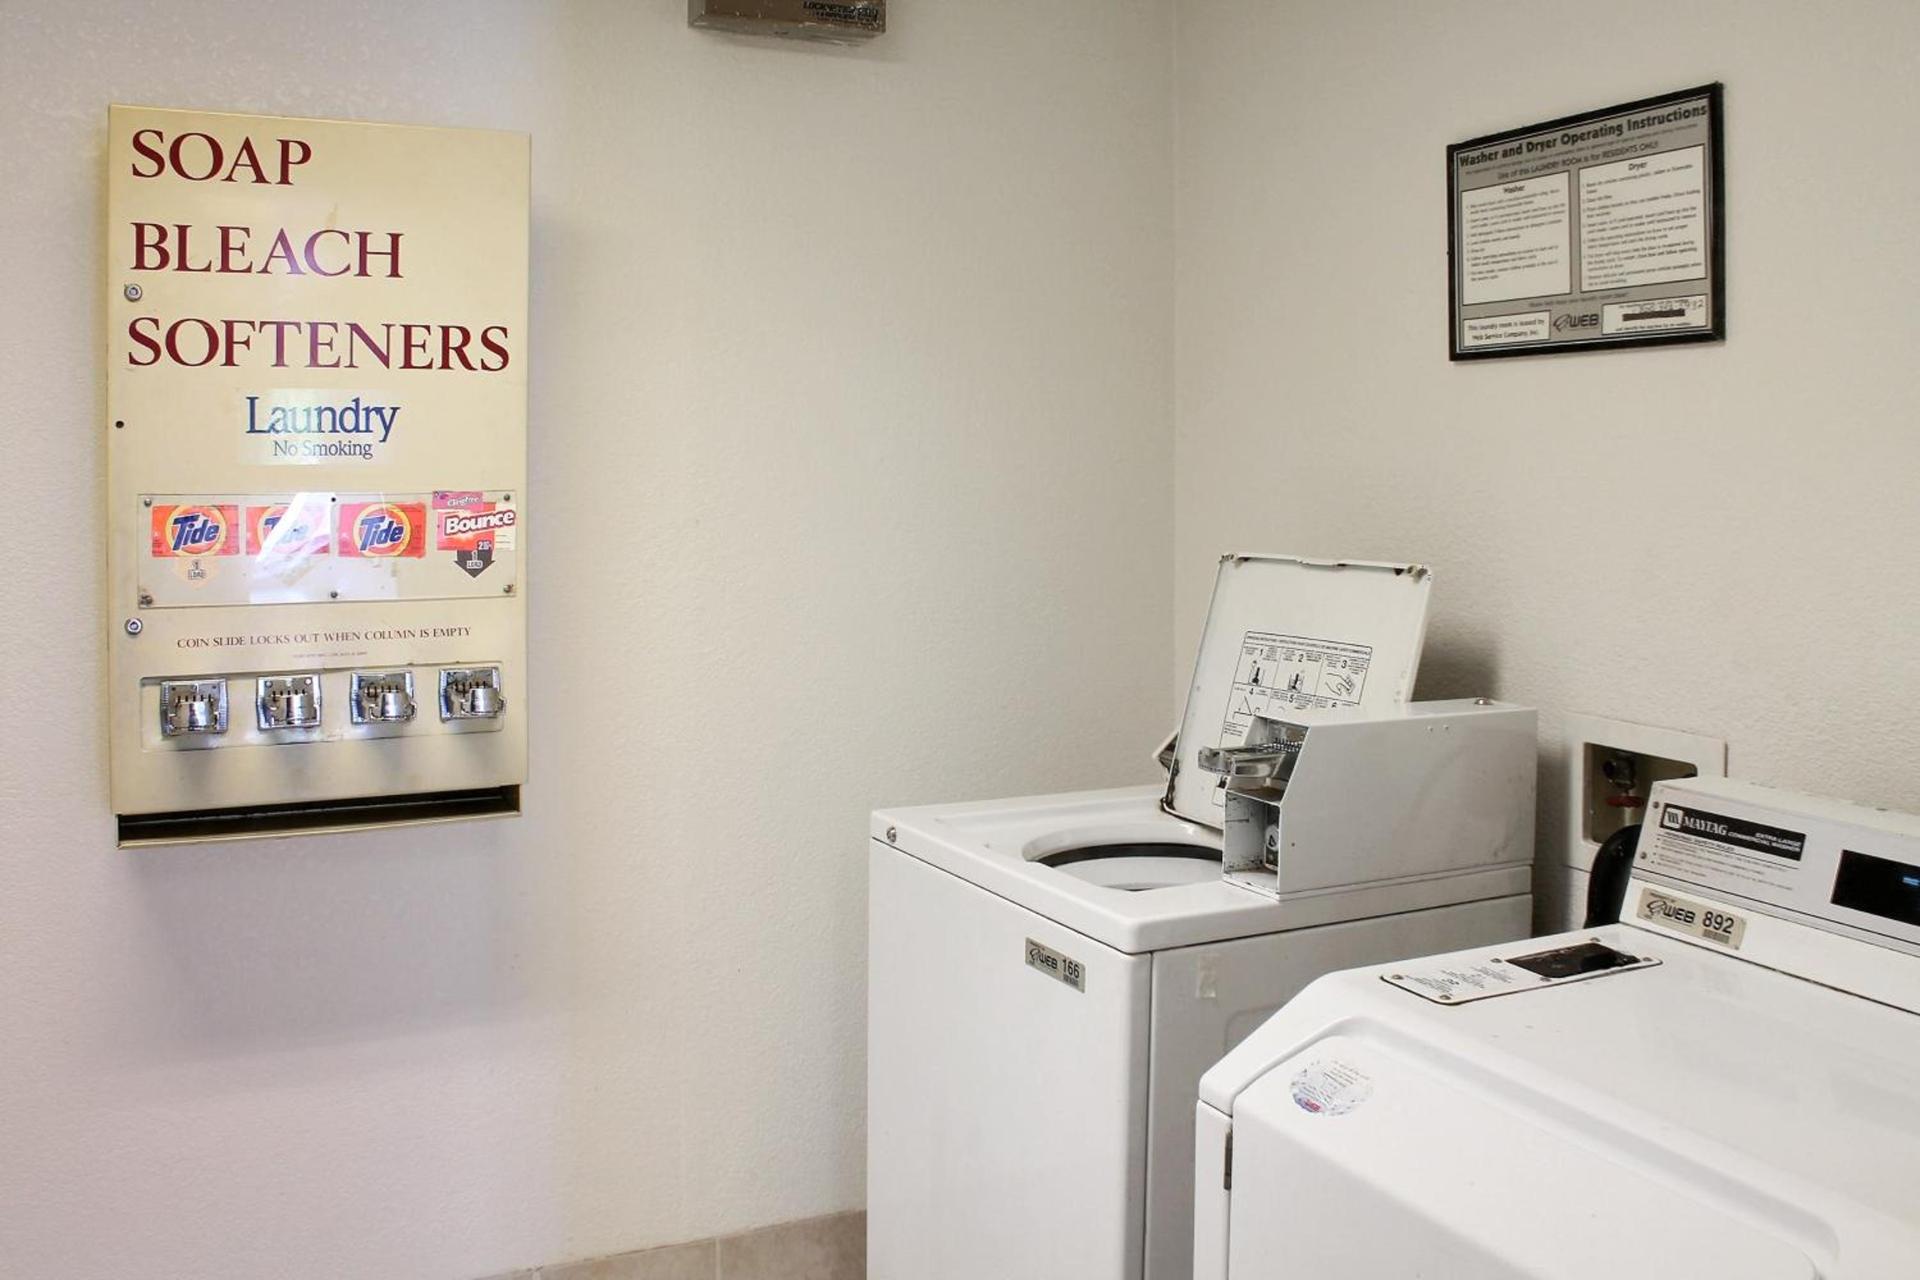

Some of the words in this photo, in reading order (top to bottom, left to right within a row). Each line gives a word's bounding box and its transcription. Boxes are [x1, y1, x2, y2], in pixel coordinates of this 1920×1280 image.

[1460, 150, 1499, 168] Washer
[1502, 143, 1523, 158] and
[1526, 137, 1557, 154] Dryer
[1561, 122, 1623, 145] Operating
[1627, 104, 1707, 131] Instructions
[131, 128, 311, 185] SOAP
[1531, 161, 1559, 173] LAUNDRY
[1562, 157, 1581, 167] ROOM
[1602, 144, 1638, 158] RESIDENTS
[1628, 162, 1648, 172] Dryer
[1503, 185, 1525, 194] Washer
[130, 222, 405, 279] BLEACH
[1569, 313, 1599, 328] WEB
[127, 317, 510, 372] SOFTENERS
[1484, 332, 1502, 340] Service
[246, 396, 400, 443] Laundry
[273, 440, 298, 457] No
[302, 439, 373, 460] Smoking
[172, 512, 220, 551] Tide
[359, 515, 404, 552] Tide
[444, 509, 516, 537] Bounce
[177, 638, 209, 648] COIN
[212, 636, 246, 647] SLIDE
[250, 634, 291, 645] LOCKS
[294, 632, 320, 643] OUT
[323, 631, 361, 641] WHEN
[364, 629, 416, 640] COLUMN
[420, 628, 430, 638] IS
[433, 626, 471, 637] EMPTY
[1298, 653, 1304, 662] 2
[1341, 659, 1348, 669] 3
[1682, 816, 1728, 836] MAYTAG
[1663, 904, 1696, 924] WEB
[1702, 910, 1735, 935] 892
[1063, 957, 1080, 979] 166
